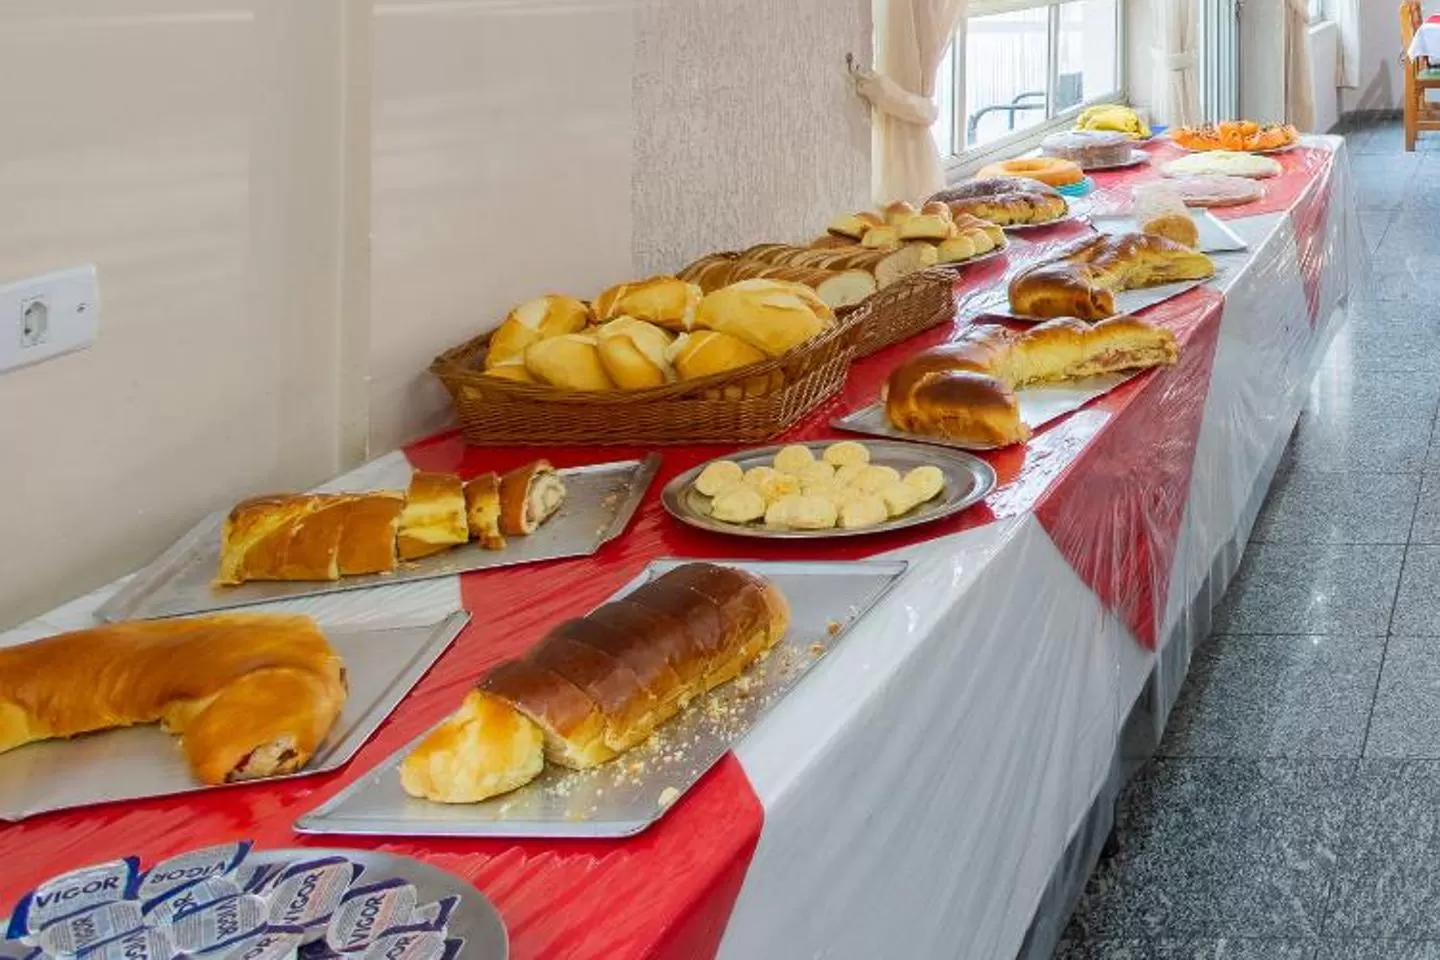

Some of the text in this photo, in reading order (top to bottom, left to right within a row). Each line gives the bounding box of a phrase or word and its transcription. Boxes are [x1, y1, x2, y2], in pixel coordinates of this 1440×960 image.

[36, 876, 120, 909] VIGOR
[150, 861, 226, 885] VIGOR
[284, 869, 326, 923] VIGOR
[350, 892, 386, 946] VIGOR
